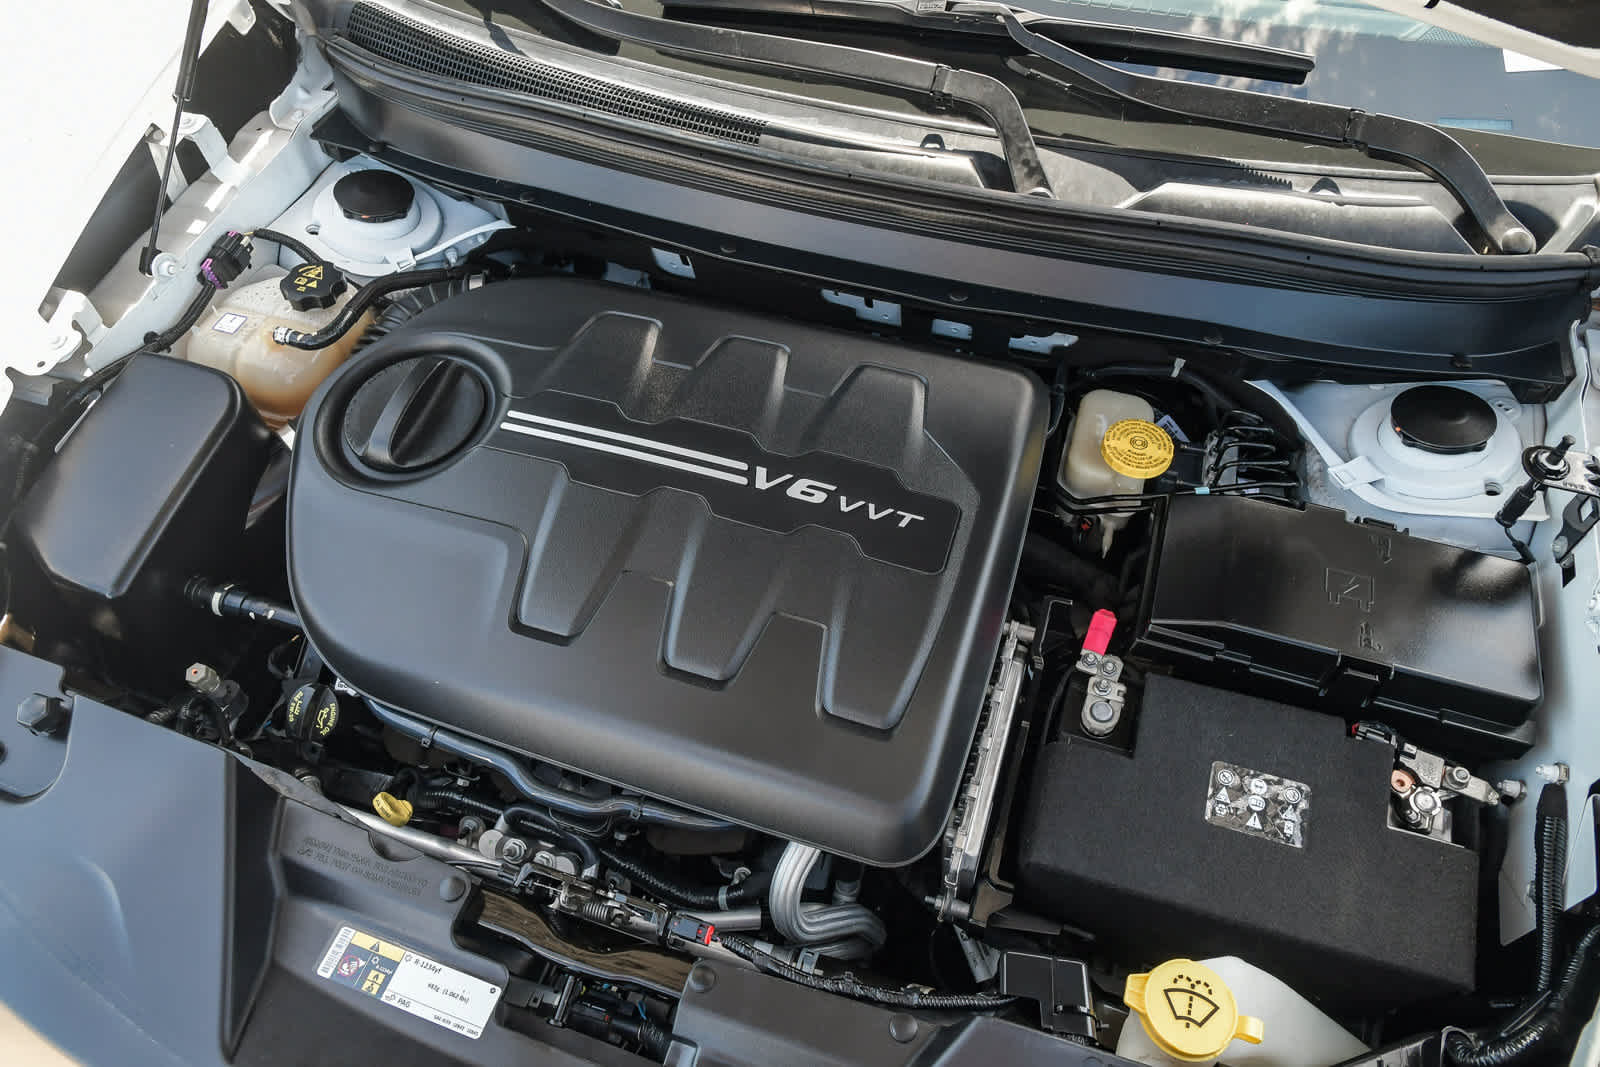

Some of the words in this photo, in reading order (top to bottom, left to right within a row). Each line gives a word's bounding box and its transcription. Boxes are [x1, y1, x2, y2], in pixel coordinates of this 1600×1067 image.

[755, 466, 838, 504] V6
[840, 495, 925, 528] VVT
[327, 703, 337, 727] ENGINE
[320, 727, 330, 736] OIL
[397, 997, 410, 1008] PAG
